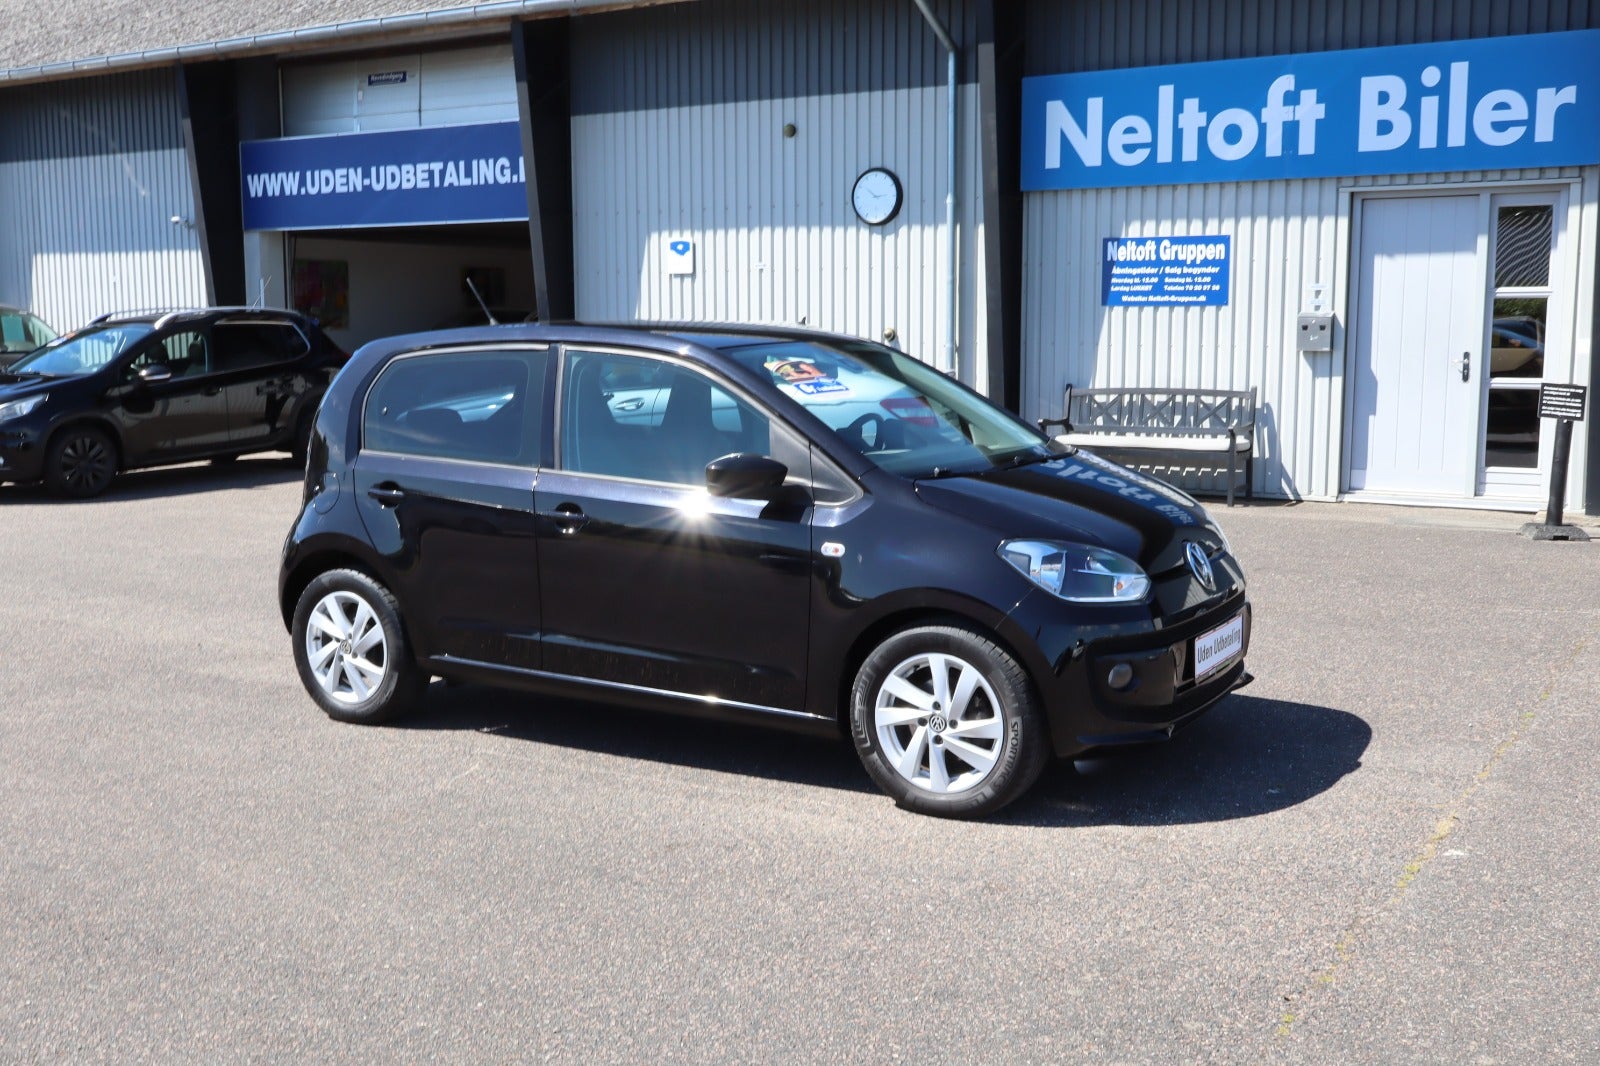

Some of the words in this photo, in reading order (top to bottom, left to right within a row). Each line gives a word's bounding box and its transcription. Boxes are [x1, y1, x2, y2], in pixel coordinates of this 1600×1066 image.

[1045, 74, 1325, 170] Neltoft
[1358, 61, 1577, 153] Biler
[1107, 240, 1157, 262] Neltoft
[1160, 239, 1226, 265] Gruppen
[1197, 644, 1213, 664] Uden
[1213, 627, 1241, 655] Udbetaling
